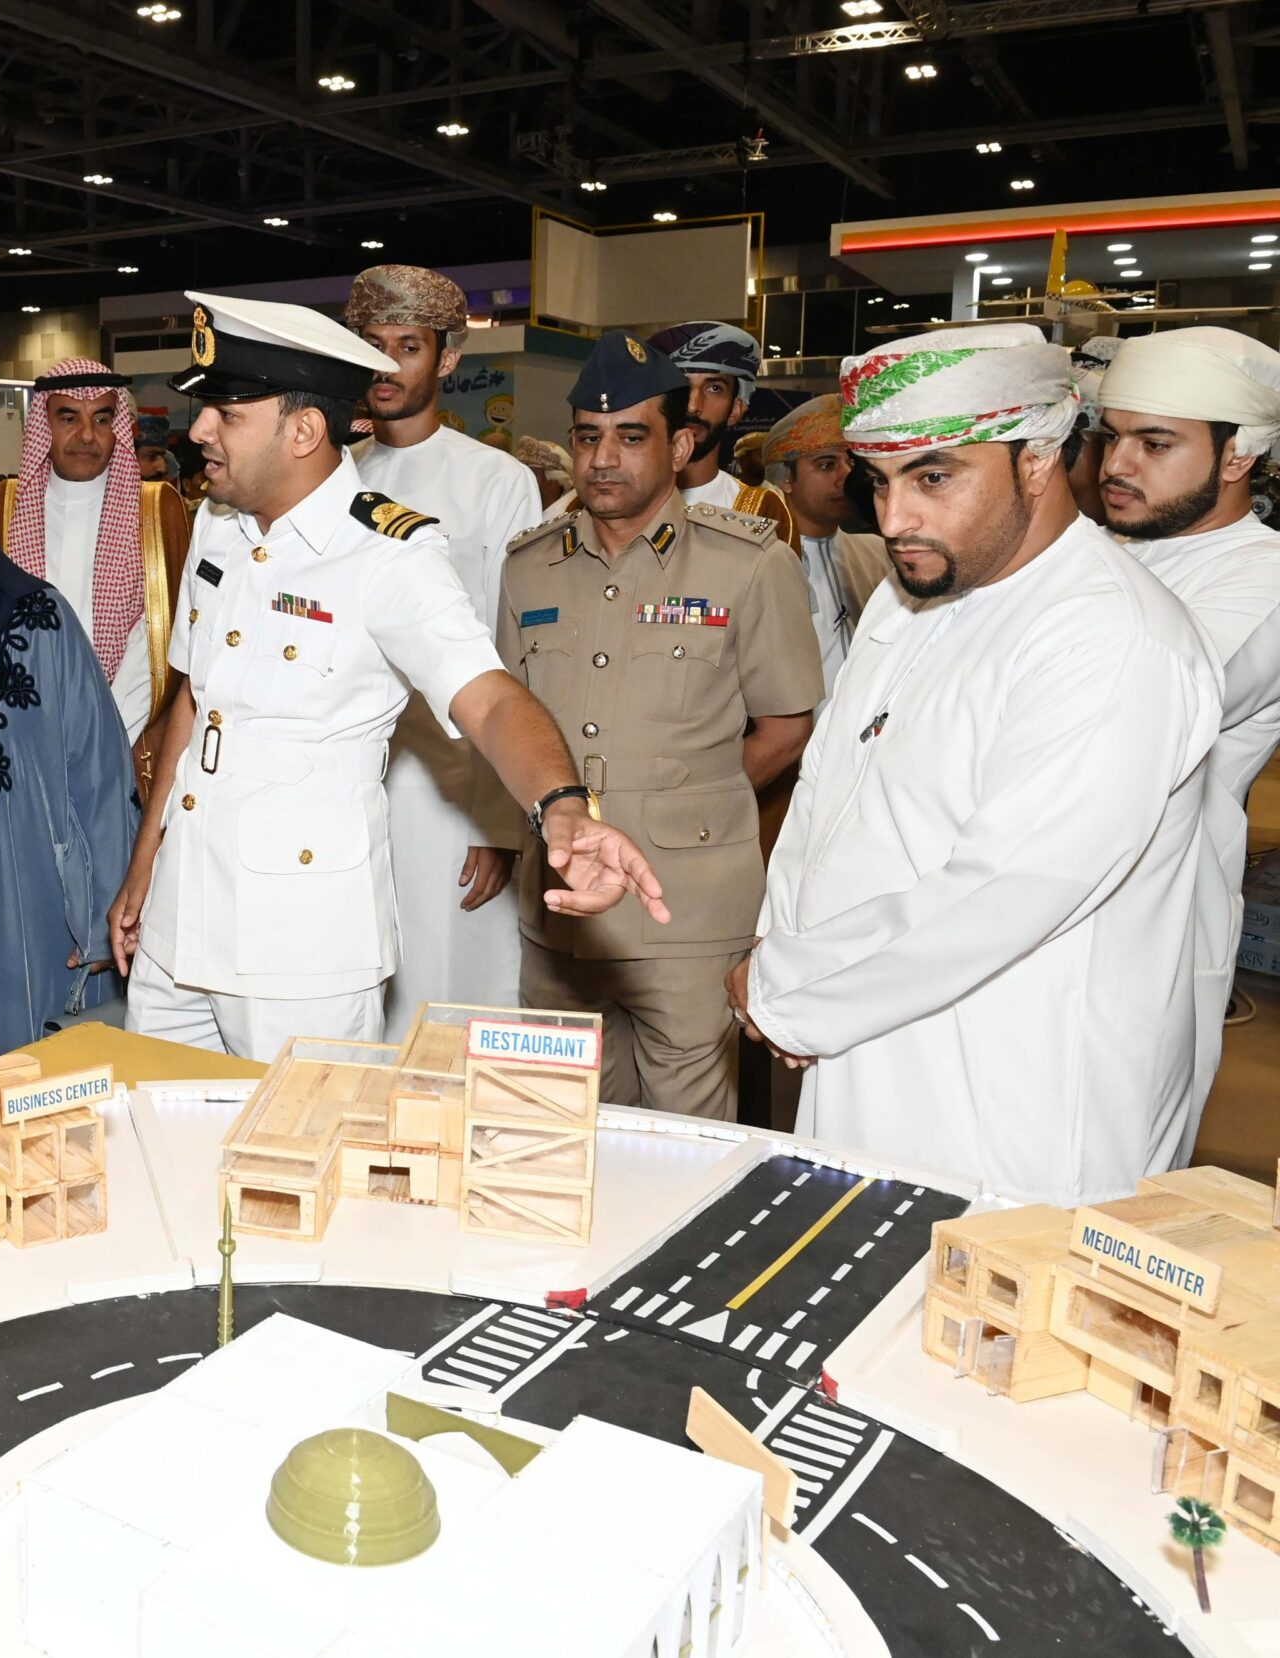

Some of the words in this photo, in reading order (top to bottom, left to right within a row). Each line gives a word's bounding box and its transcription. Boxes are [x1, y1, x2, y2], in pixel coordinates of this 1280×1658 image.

[480, 1029, 586, 1058] RESTAURANT
[7, 1089, 62, 1114] BUSINESS
[65, 1078, 108, 1101] CENTER
[1082, 1226, 1141, 1270] MEDICAL
[1146, 1255, 1205, 1297] CENTER
